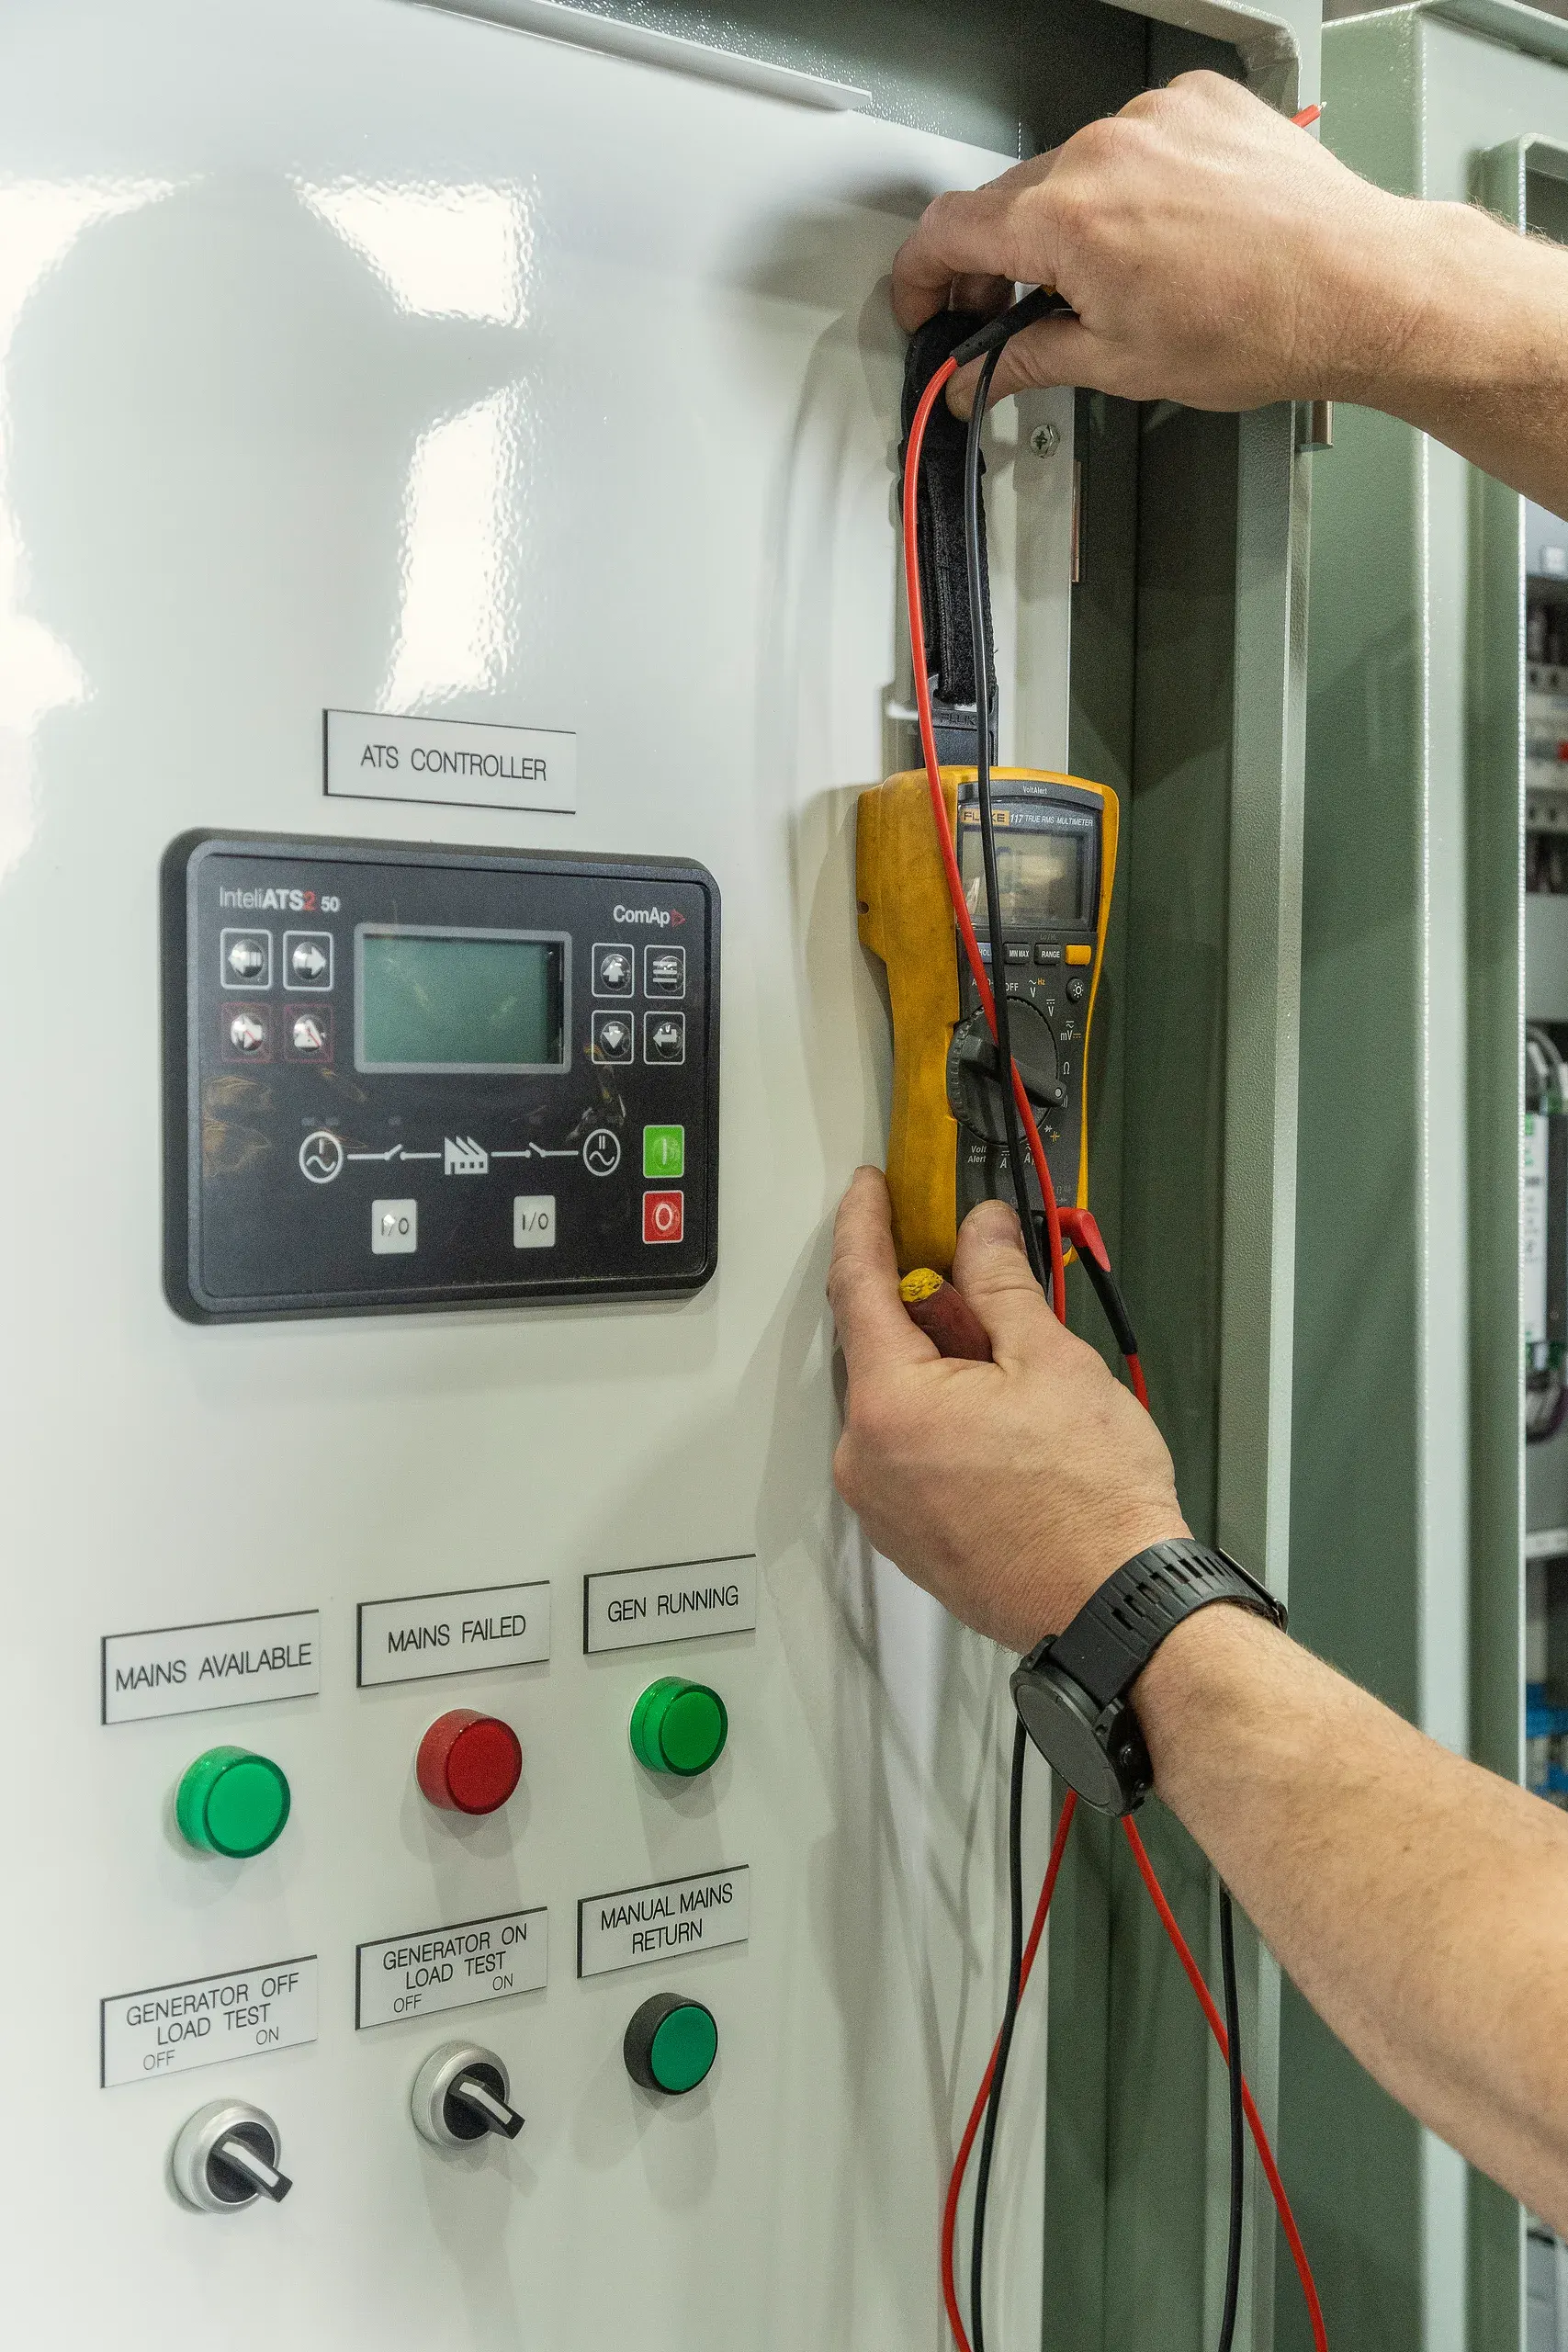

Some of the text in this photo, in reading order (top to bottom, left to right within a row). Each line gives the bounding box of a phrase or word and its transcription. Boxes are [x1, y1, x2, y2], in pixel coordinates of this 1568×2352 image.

[941, 712, 977, 726] FLUK
[360, 744, 547, 781] ATS CONTROLLER
[1022, 786, 1048, 795] VoltAlert
[964, 812, 1094, 827] FLKE 117 TRUE RMS MULTIMETER
[220, 887, 342, 913] InteliATS2 50
[613, 904, 671, 928] ComAp
[1019, 950, 1030, 958] MAX
[1041, 950, 1061, 958] RANGE
[1030, 987, 1036, 998] V
[1048, 1006, 1055, 1017] V
[1060, 1030, 1073, 1041] mV
[967, 1154, 987, 1163] Alert
[971, 1145, 987, 1153] Volt
[999, 1158, 1008, 1169] A
[608, 1585, 739, 1623] GEN RUNNING
[388, 1614, 526, 1654] MAINS FAILED
[115, 1643, 312, 1692] MAINS AVAILABLE
[601, 1883, 733, 1931] MANUAL MAINS
[383, 1923, 527, 1971] GENERATOR ON
[632, 1918, 703, 1954] RETURN
[406, 1951, 506, 1990] LOAD TEST
[126, 1972, 299, 2027] GENERATOR OFF
[393, 1973, 513, 2013] OFF ON
[157, 2002, 271, 2046] LOAD TEST
[142, 2026, 279, 2071] OFF ON
